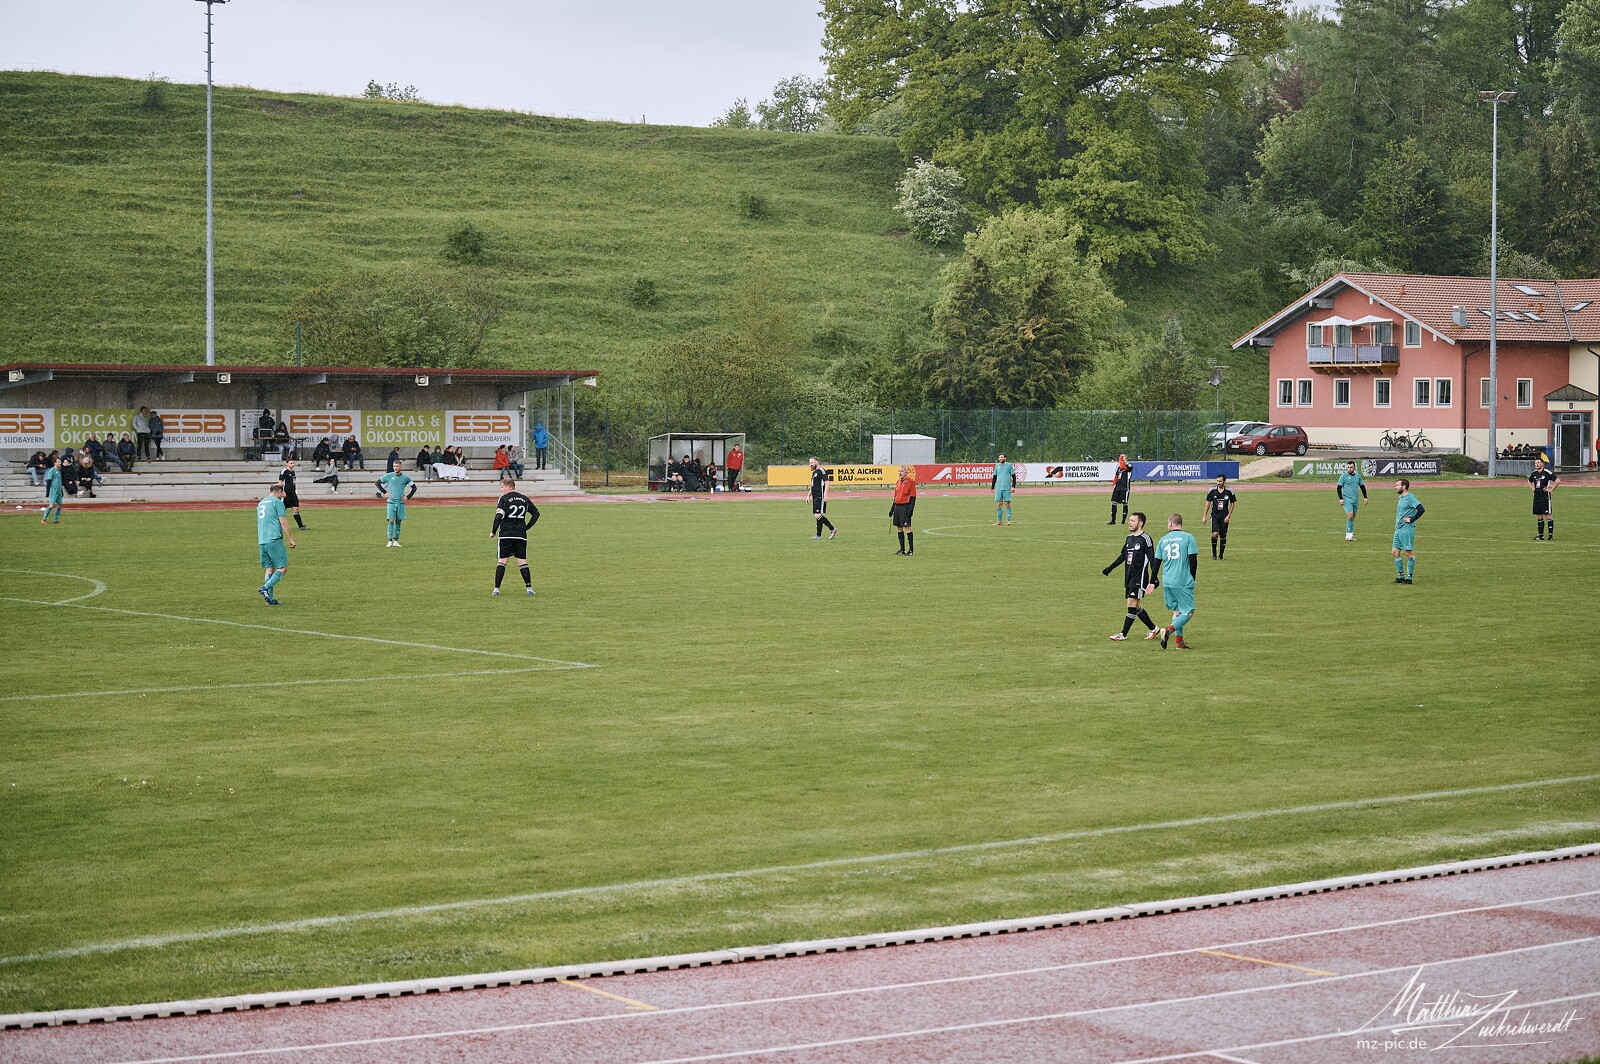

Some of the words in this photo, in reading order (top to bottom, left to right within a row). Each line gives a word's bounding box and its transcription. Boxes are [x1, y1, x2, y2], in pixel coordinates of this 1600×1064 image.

[0, 414, 45, 433] SB
[60, 414, 127, 427] ERDGAS
[160, 414, 227, 433] ESB
[290, 415, 353, 433] ESB
[366, 415, 425, 427] ERDGAS
[431, 415, 440, 427] &
[453, 415, 512, 433] ESB
[188, 435, 226, 443] SÜDBAYERN
[366, 428, 440, 443] ÖKOSTROM
[259, 505, 266, 519] 3
[508, 505, 526, 518] 22
[1164, 543, 1181, 560] 13
